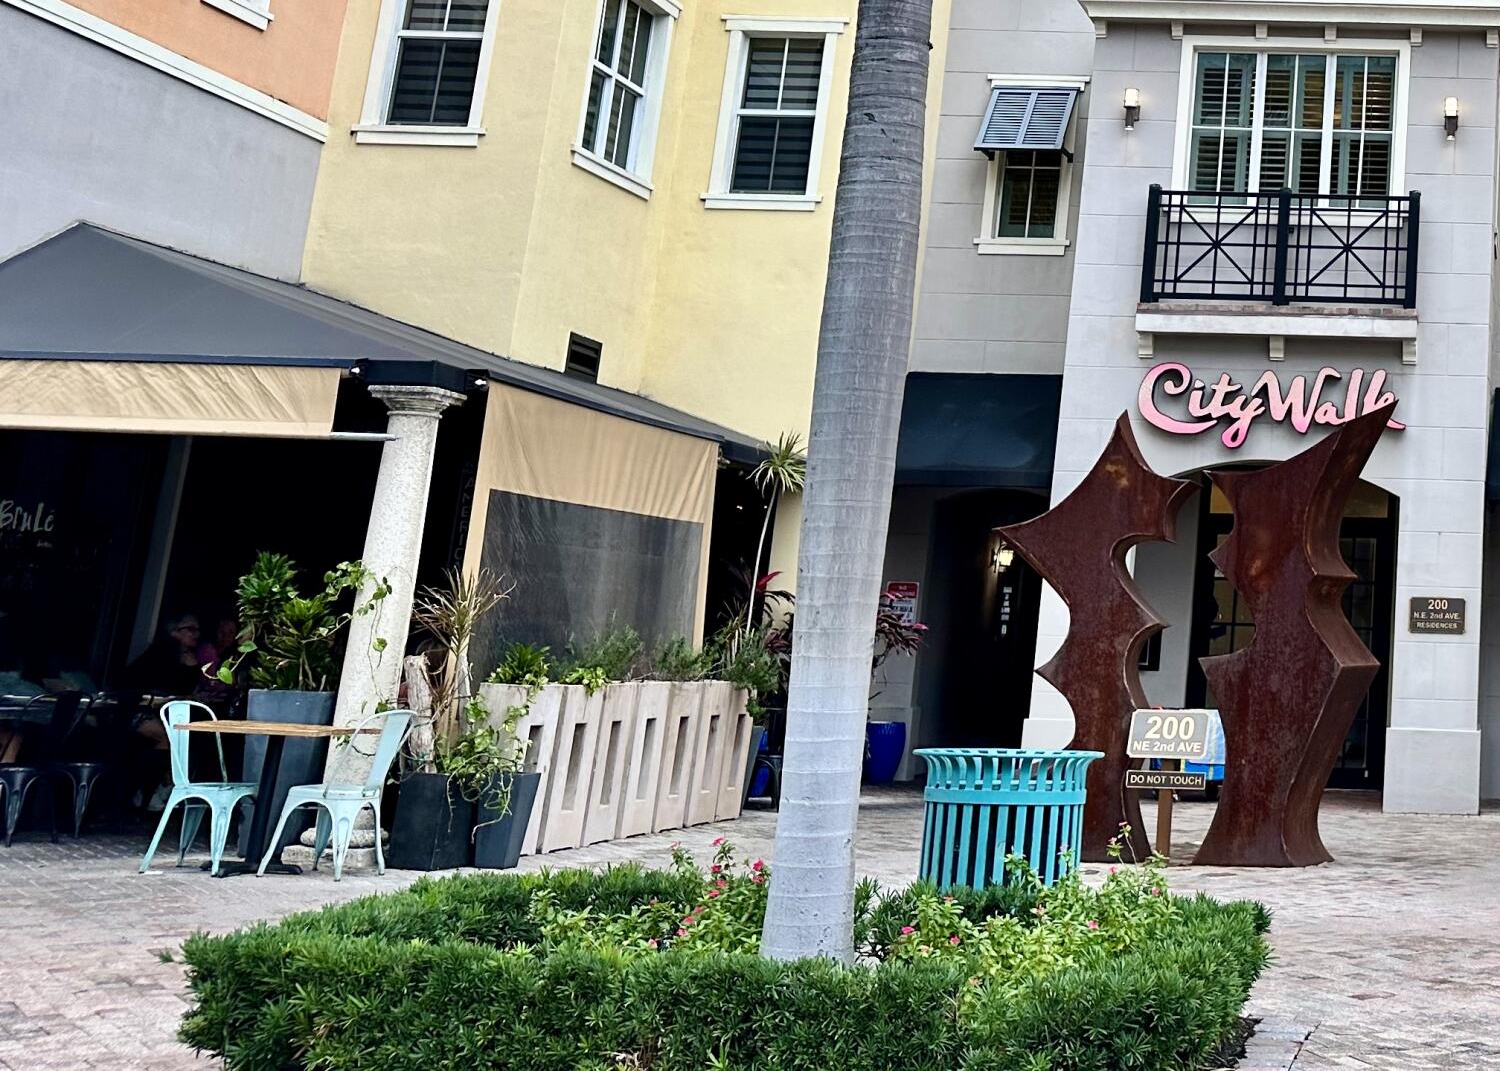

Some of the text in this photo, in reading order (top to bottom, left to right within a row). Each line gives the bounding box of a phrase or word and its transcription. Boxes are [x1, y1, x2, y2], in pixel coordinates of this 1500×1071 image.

[1427, 599, 1449, 610] 200
[1145, 715, 1195, 740] 200
[1133, 740, 1202, 753] NE 2nd AVE
[1130, 774, 1202, 786] DO NOT TOUCH
